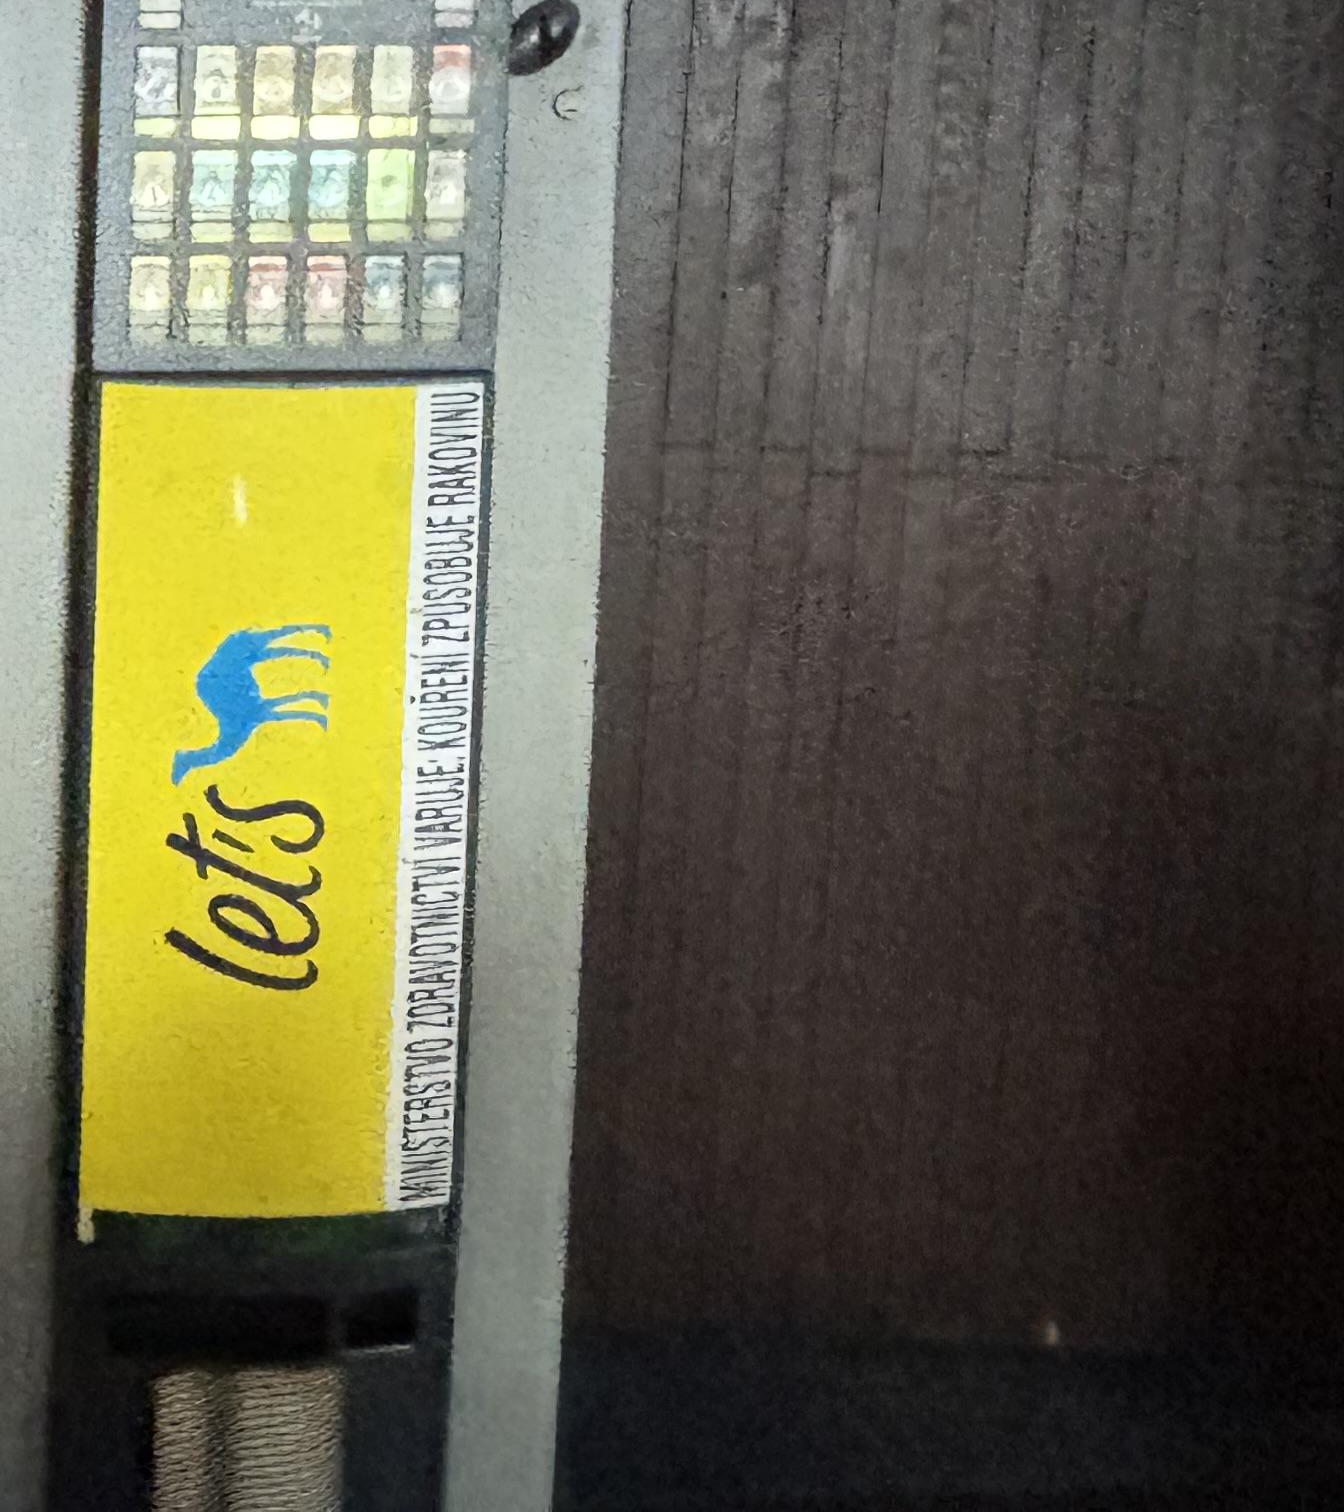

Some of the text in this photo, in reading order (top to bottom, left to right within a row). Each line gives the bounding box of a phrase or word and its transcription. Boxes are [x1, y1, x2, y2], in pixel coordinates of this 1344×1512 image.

[426, 390, 480, 508] RAKOVINU
[409, 651, 470, 751] KOUŘENÍ
[165, 784, 325, 991] let's
[402, 855, 462, 1034] ZDRAVOTNICTVÍ
[397, 1036, 455, 1203] MINISTERSTVO
